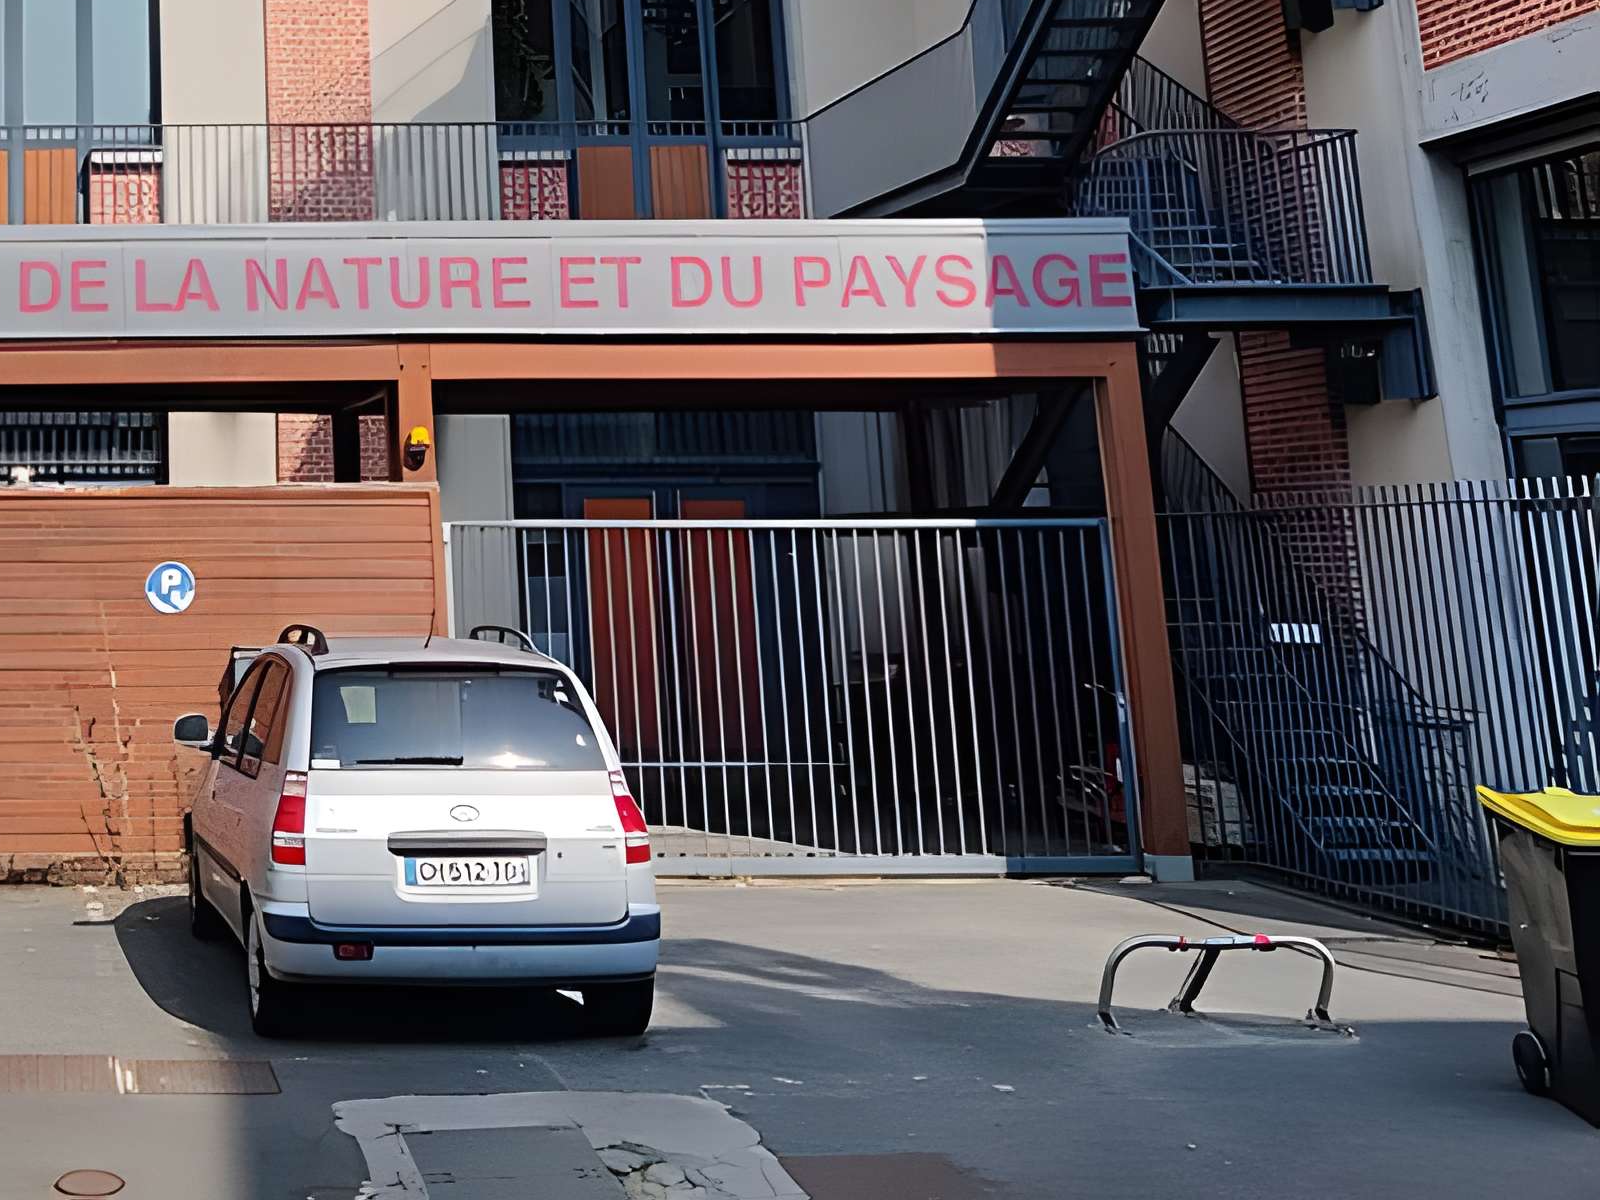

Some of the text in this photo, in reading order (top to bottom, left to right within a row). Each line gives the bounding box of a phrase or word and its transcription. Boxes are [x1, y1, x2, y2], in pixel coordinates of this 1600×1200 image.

[18, 259, 110, 315] DE
[135, 257, 221, 313] LA
[244, 255, 533, 312] NATURE
[559, 255, 643, 310] ET
[670, 255, 765, 309] DU
[792, 253, 1132, 310] PAYSAGE
[161, 568, 182, 595] P
